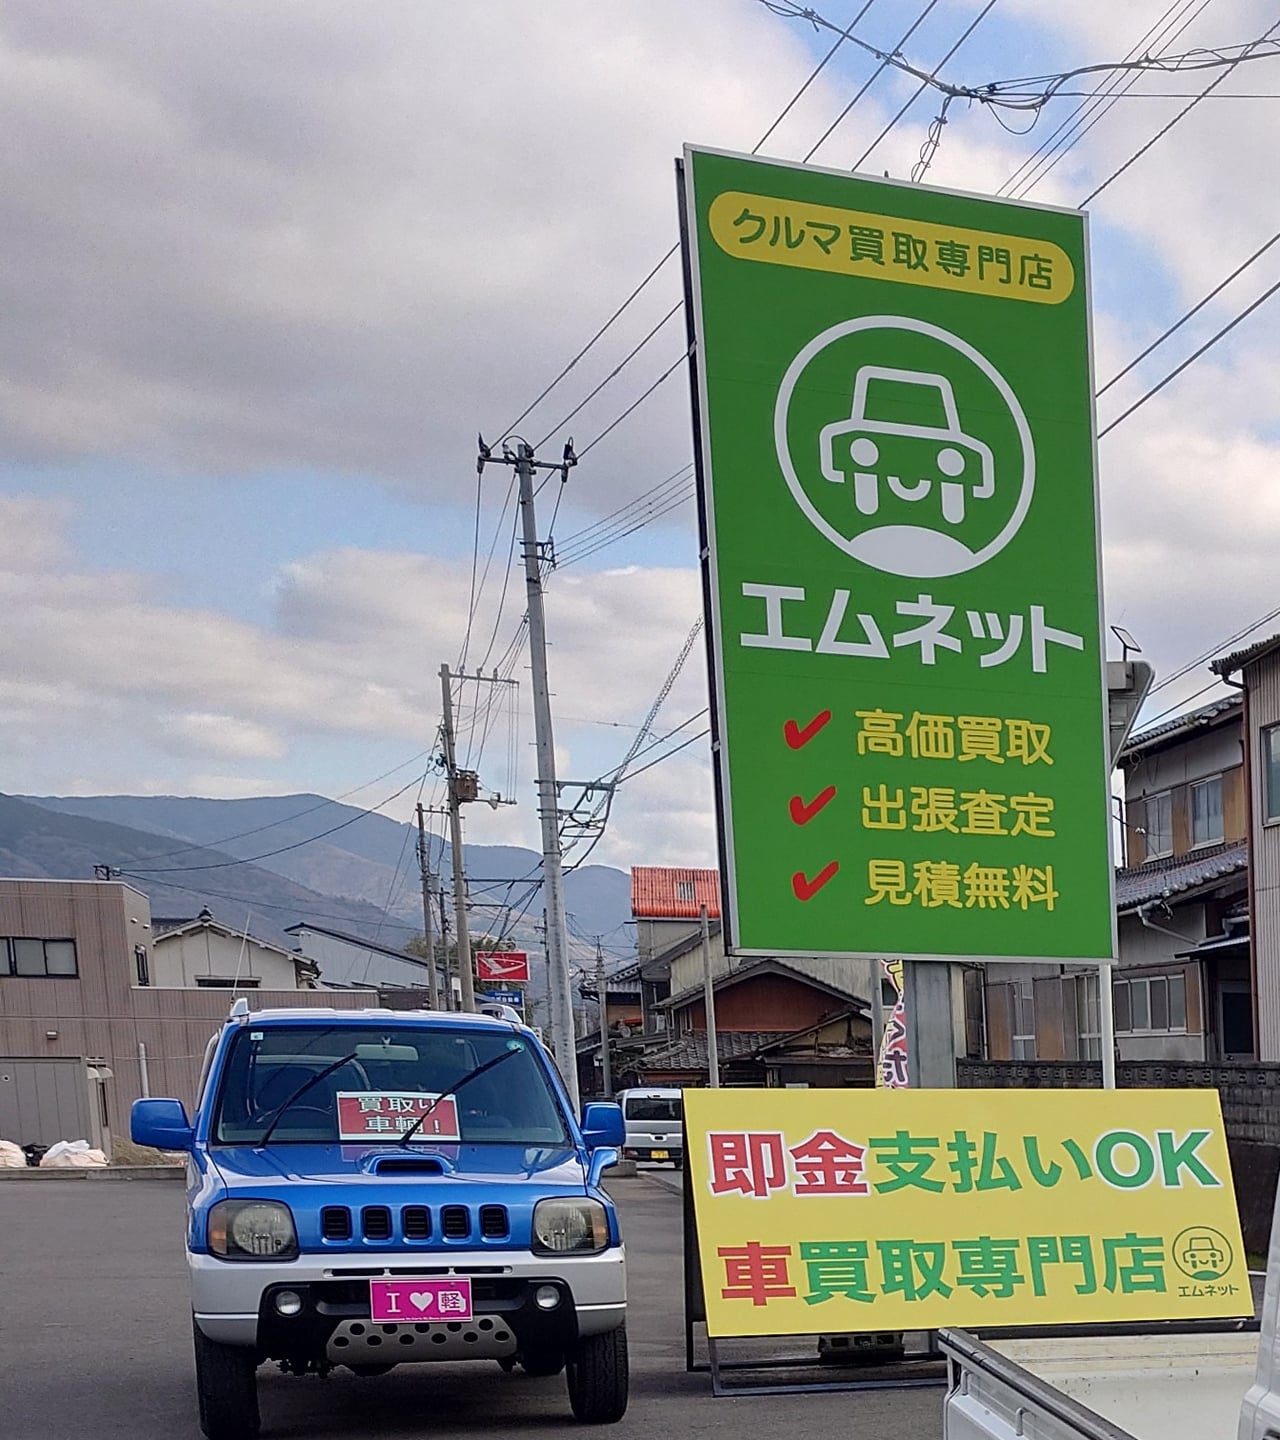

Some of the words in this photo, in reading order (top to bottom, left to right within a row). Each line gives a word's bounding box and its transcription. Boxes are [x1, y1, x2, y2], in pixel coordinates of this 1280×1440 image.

[732, 208, 1053, 290] クルマ買取専門店
[740, 582, 1084, 673] エムネット
[855, 708, 1054, 766] 高価買取
[861, 784, 1056, 837] 出張査定
[864, 859, 1059, 911] 見積無料
[707, 1129, 1224, 1199] 即金支払いOK
[717, 1232, 1167, 1307] 車買取専門店
[1178, 1284, 1240, 1298] エムネット
